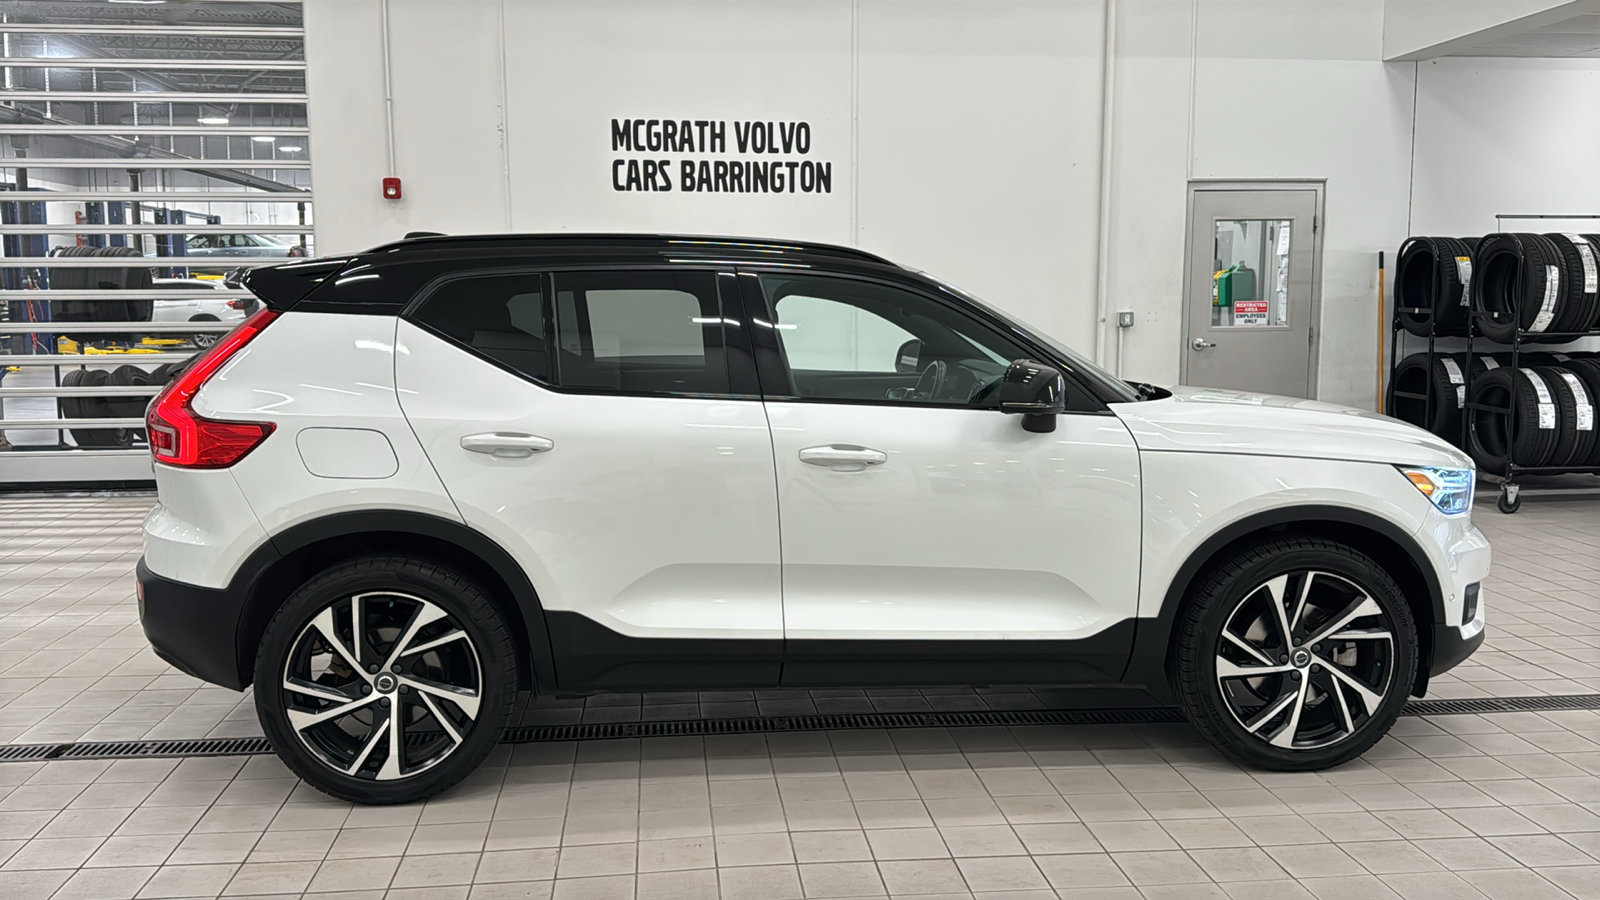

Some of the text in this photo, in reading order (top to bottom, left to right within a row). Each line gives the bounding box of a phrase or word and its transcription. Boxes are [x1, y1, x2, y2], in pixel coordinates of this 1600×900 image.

[611, 119, 811, 154] MCGRATH VOLVO
[612, 159, 832, 193] CARS BARRINGTON
